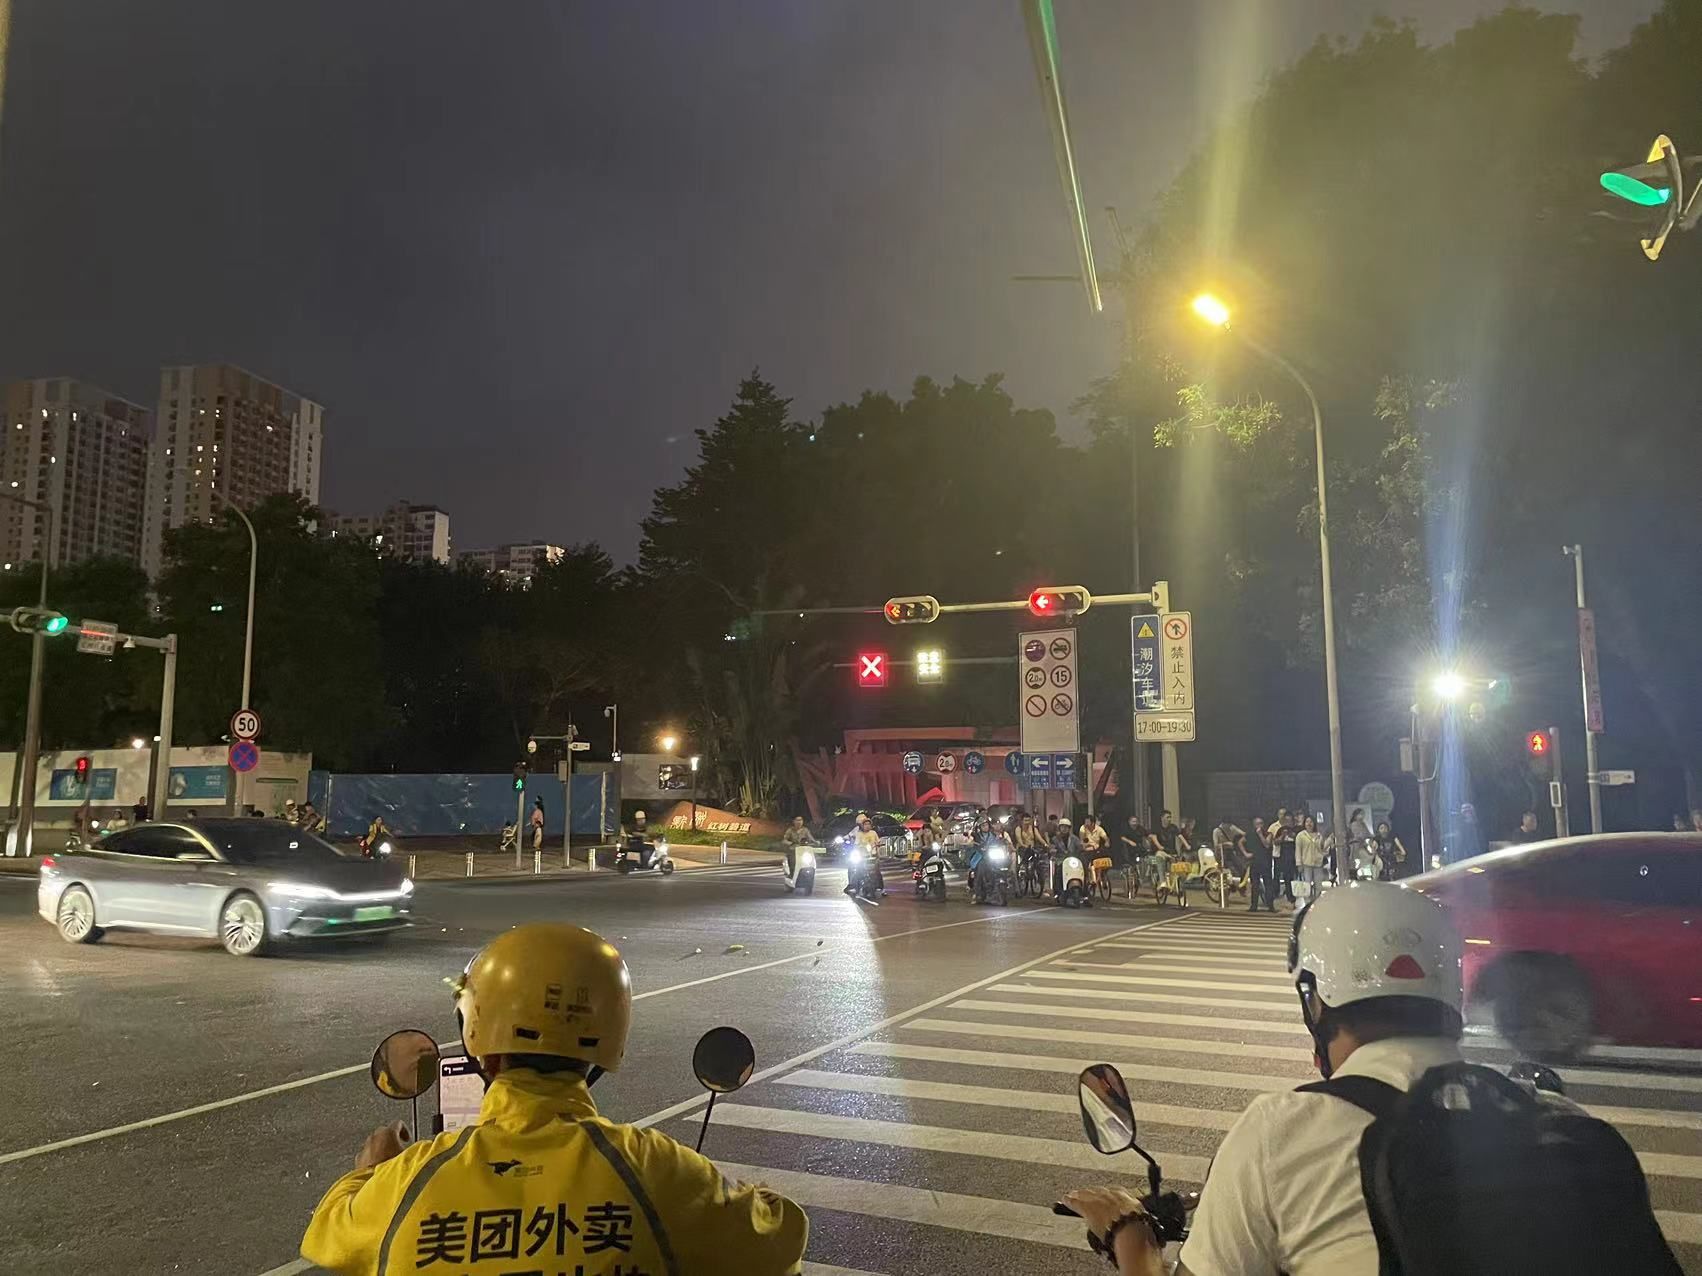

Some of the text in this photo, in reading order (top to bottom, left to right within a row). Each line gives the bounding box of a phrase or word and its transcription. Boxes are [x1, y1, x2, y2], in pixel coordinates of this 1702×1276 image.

[1055, 671, 1068, 683] 15
[1171, 646, 1185, 705] 禁止入内
[239, 717, 255, 732] 50
[1138, 722, 1192, 733] 17:00-19:30
[416, 1201, 633, 1269] 美团外卖
